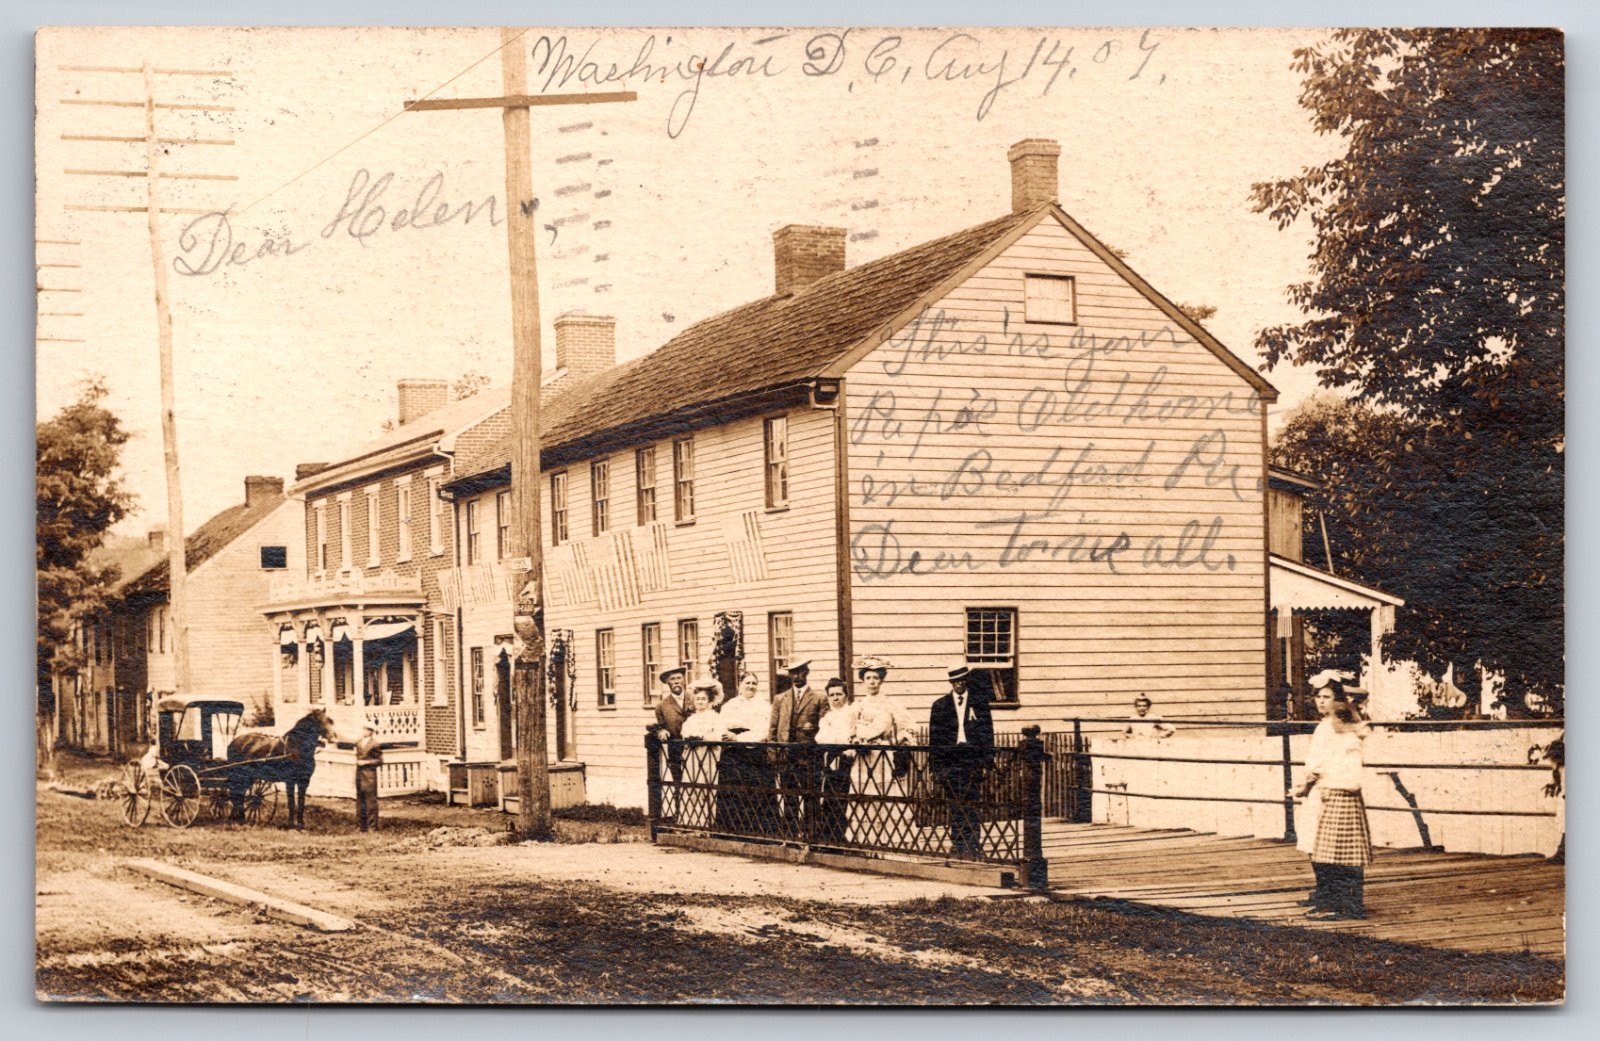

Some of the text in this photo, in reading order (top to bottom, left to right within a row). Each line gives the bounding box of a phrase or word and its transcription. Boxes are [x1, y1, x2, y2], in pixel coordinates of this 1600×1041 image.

[531, 34, 789, 139] Washington
[173, 201, 312, 277] Dear
[880, 302, 988, 378] This
[1003, 305, 1057, 361] is
[940, 440, 1156, 517] Bedford
[851, 518, 985, 583] Dear
